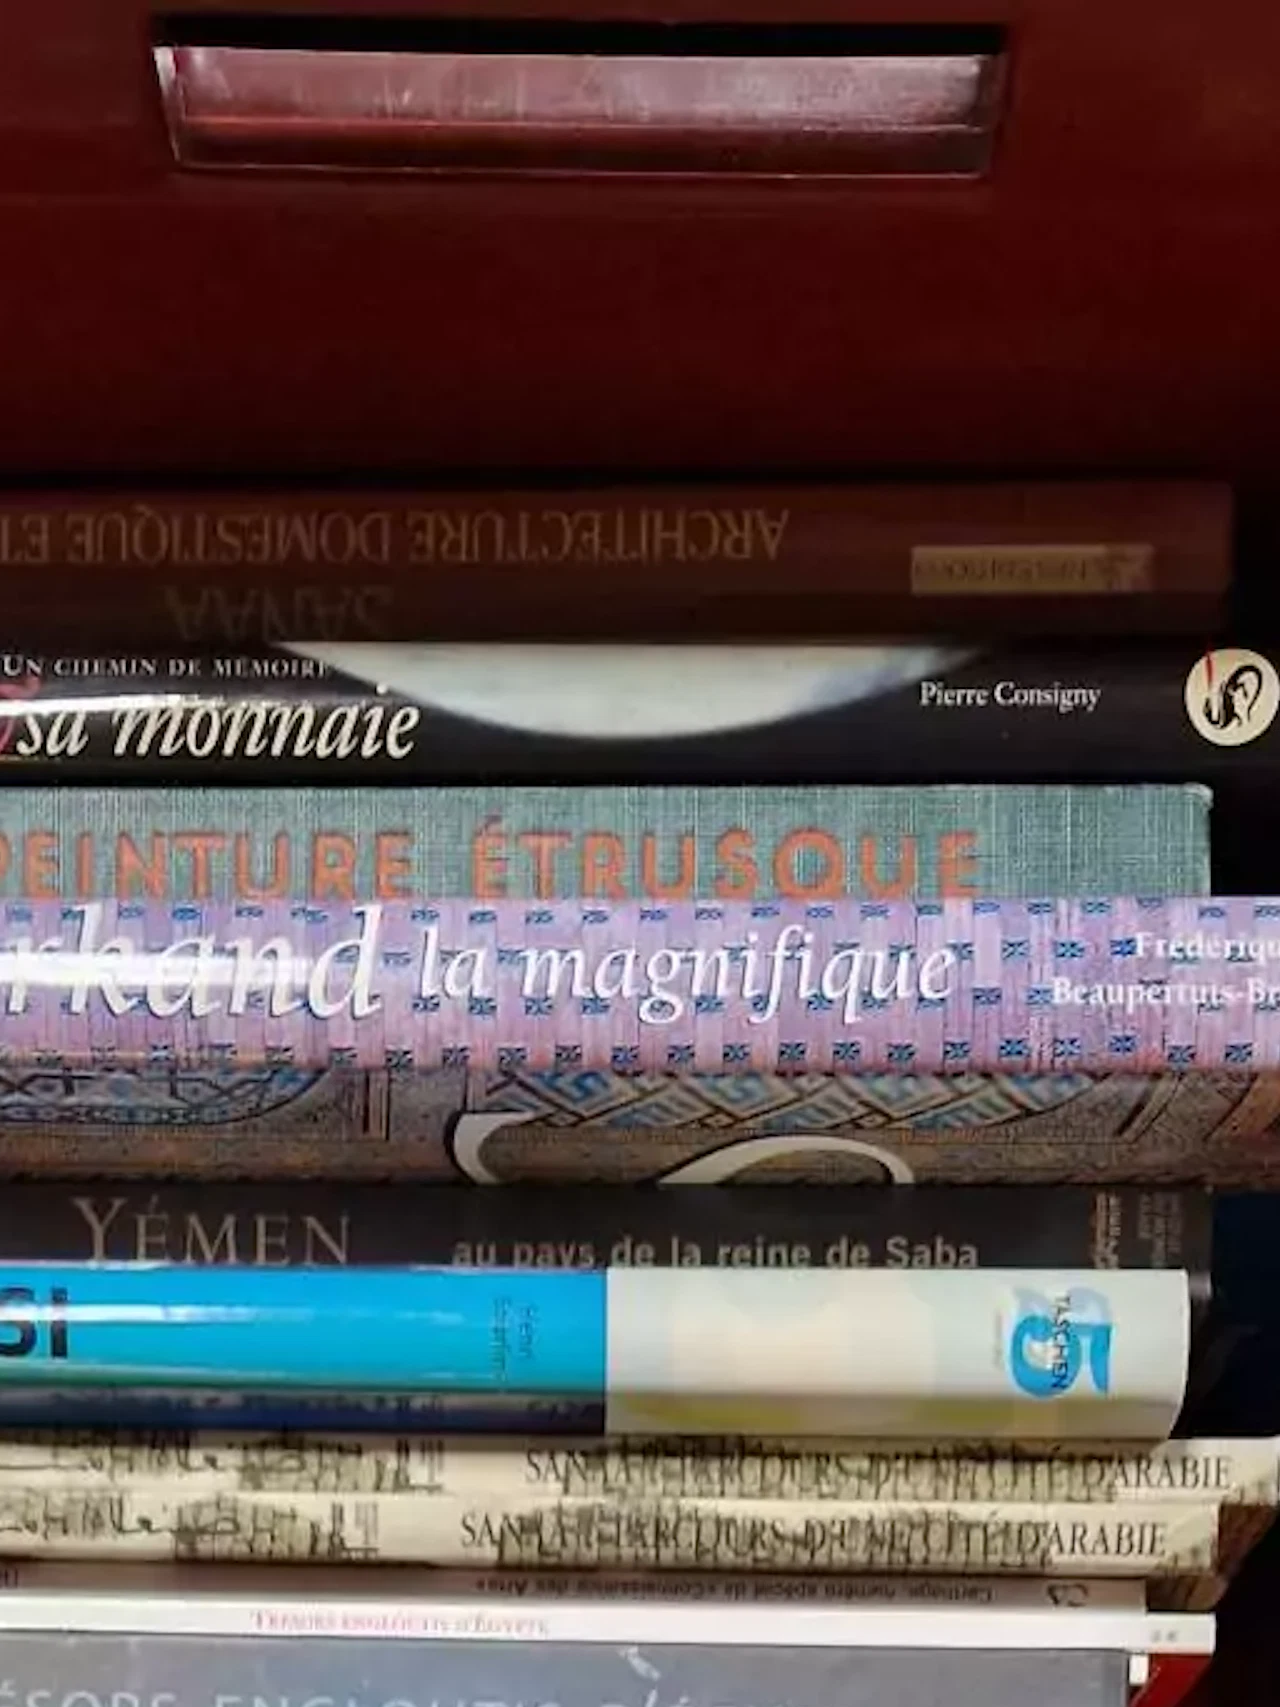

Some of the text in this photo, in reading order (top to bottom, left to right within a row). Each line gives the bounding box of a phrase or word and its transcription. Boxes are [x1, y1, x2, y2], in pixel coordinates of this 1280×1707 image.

[66, 503, 392, 572] DOMESTIQUE
[403, 505, 789, 568] ARCHITECTURE
[53, 656, 201, 681] CHEMIN DE
[920, 681, 1101, 714] Pierre Consigny
[15, 688, 421, 760] sa monnaie
[417, 925, 955, 1024] la magnifique
[74, 1193, 352, 1266] YÉMEN
[454, 1236, 497, 1266] au
[609, 1231, 648, 1268] de
[670, 1231, 702, 1268] la
[717, 1233, 794, 1268] reine
[825, 1231, 870, 1268] de
[884, 1231, 979, 1268] Saba
[1018, 1519, 1164, 1560] D'ARABIE
